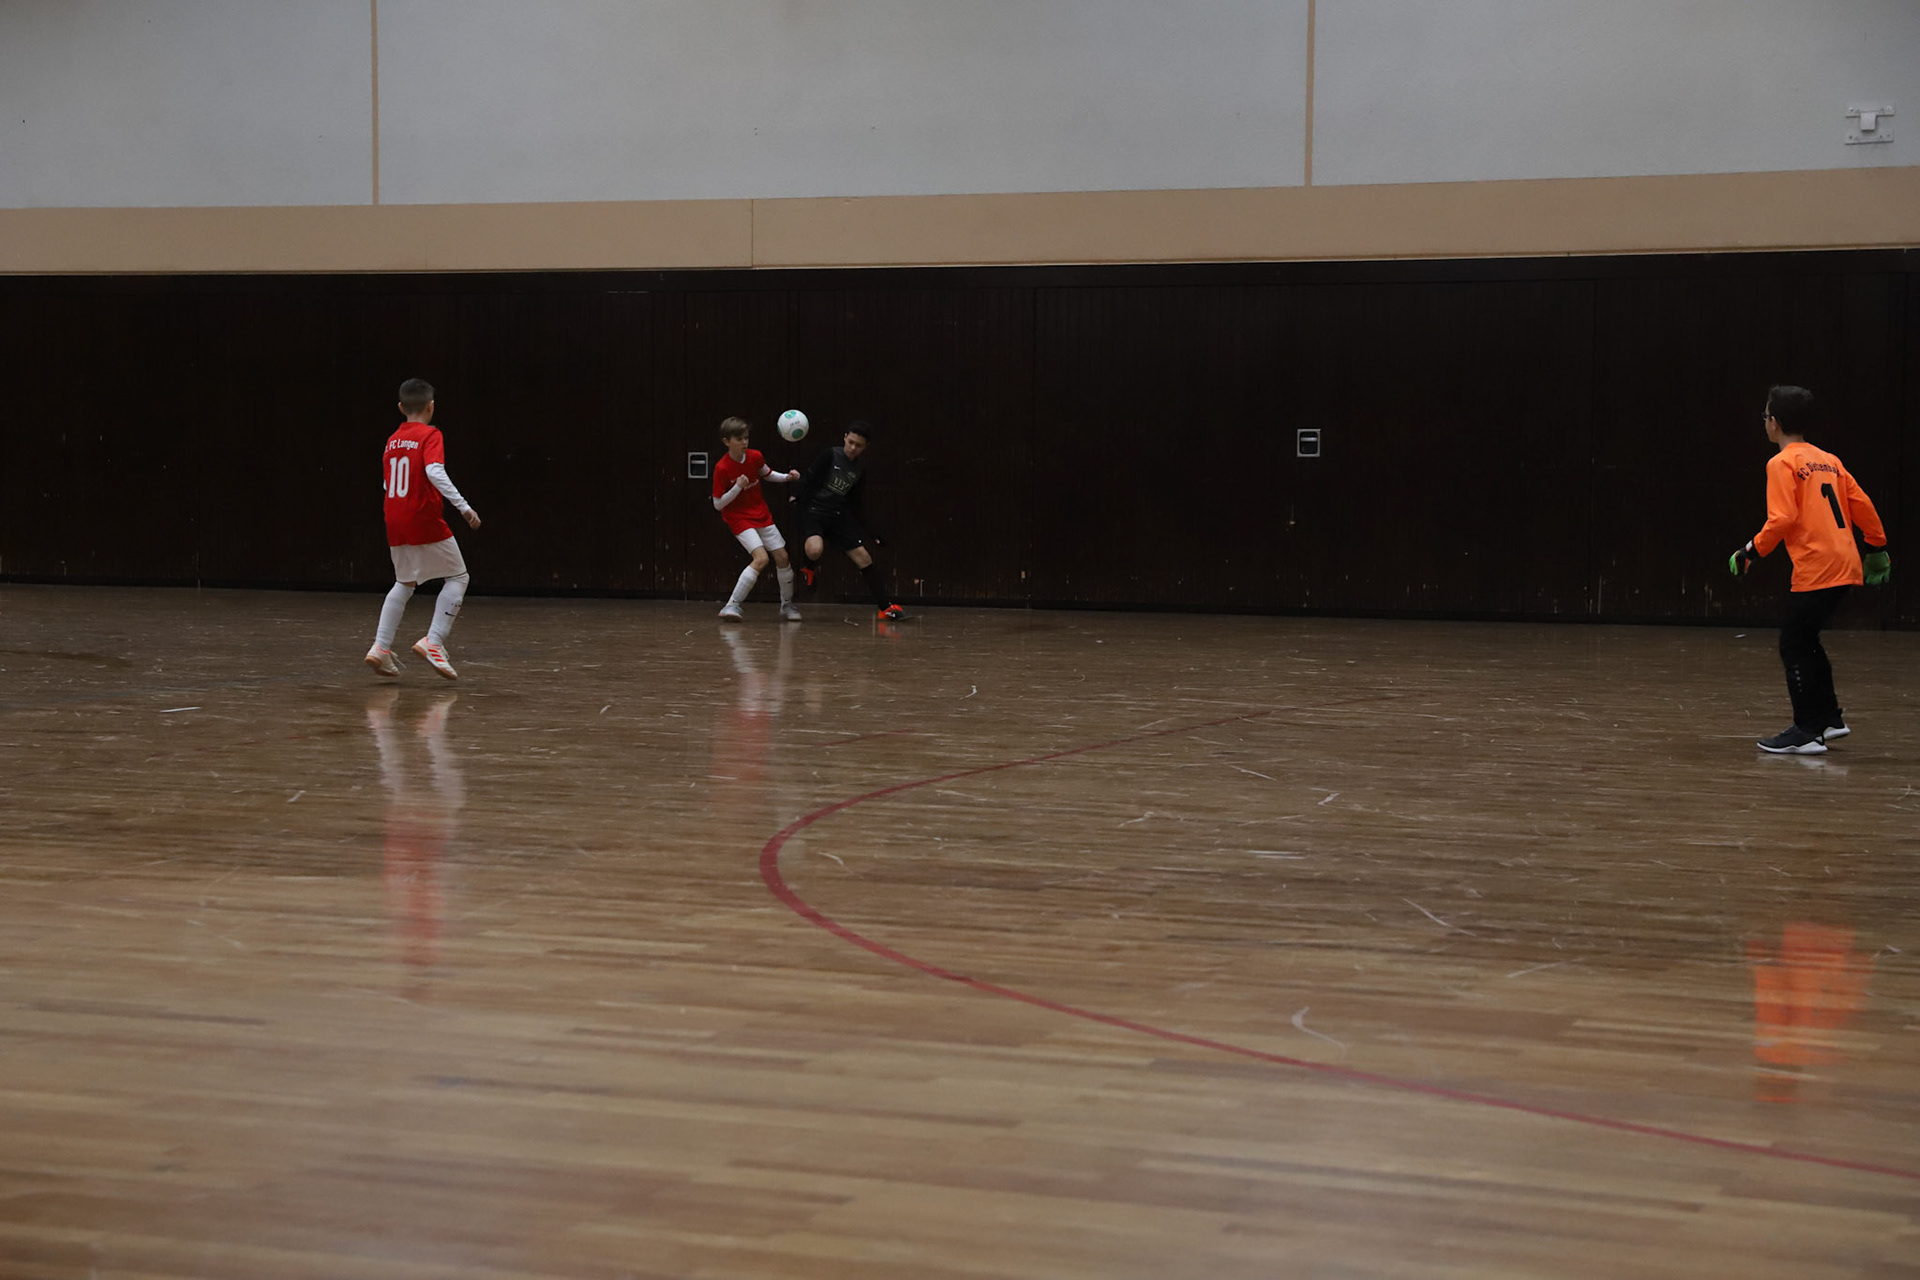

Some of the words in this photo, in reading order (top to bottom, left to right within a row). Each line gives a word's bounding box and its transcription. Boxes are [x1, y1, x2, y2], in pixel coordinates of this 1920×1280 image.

[389, 439, 397, 451] FC
[397, 438, 419, 451] Langen
[388, 455, 410, 498] 10
[1796, 467, 1810, 481] FC
[1821, 483, 1846, 529] 1
